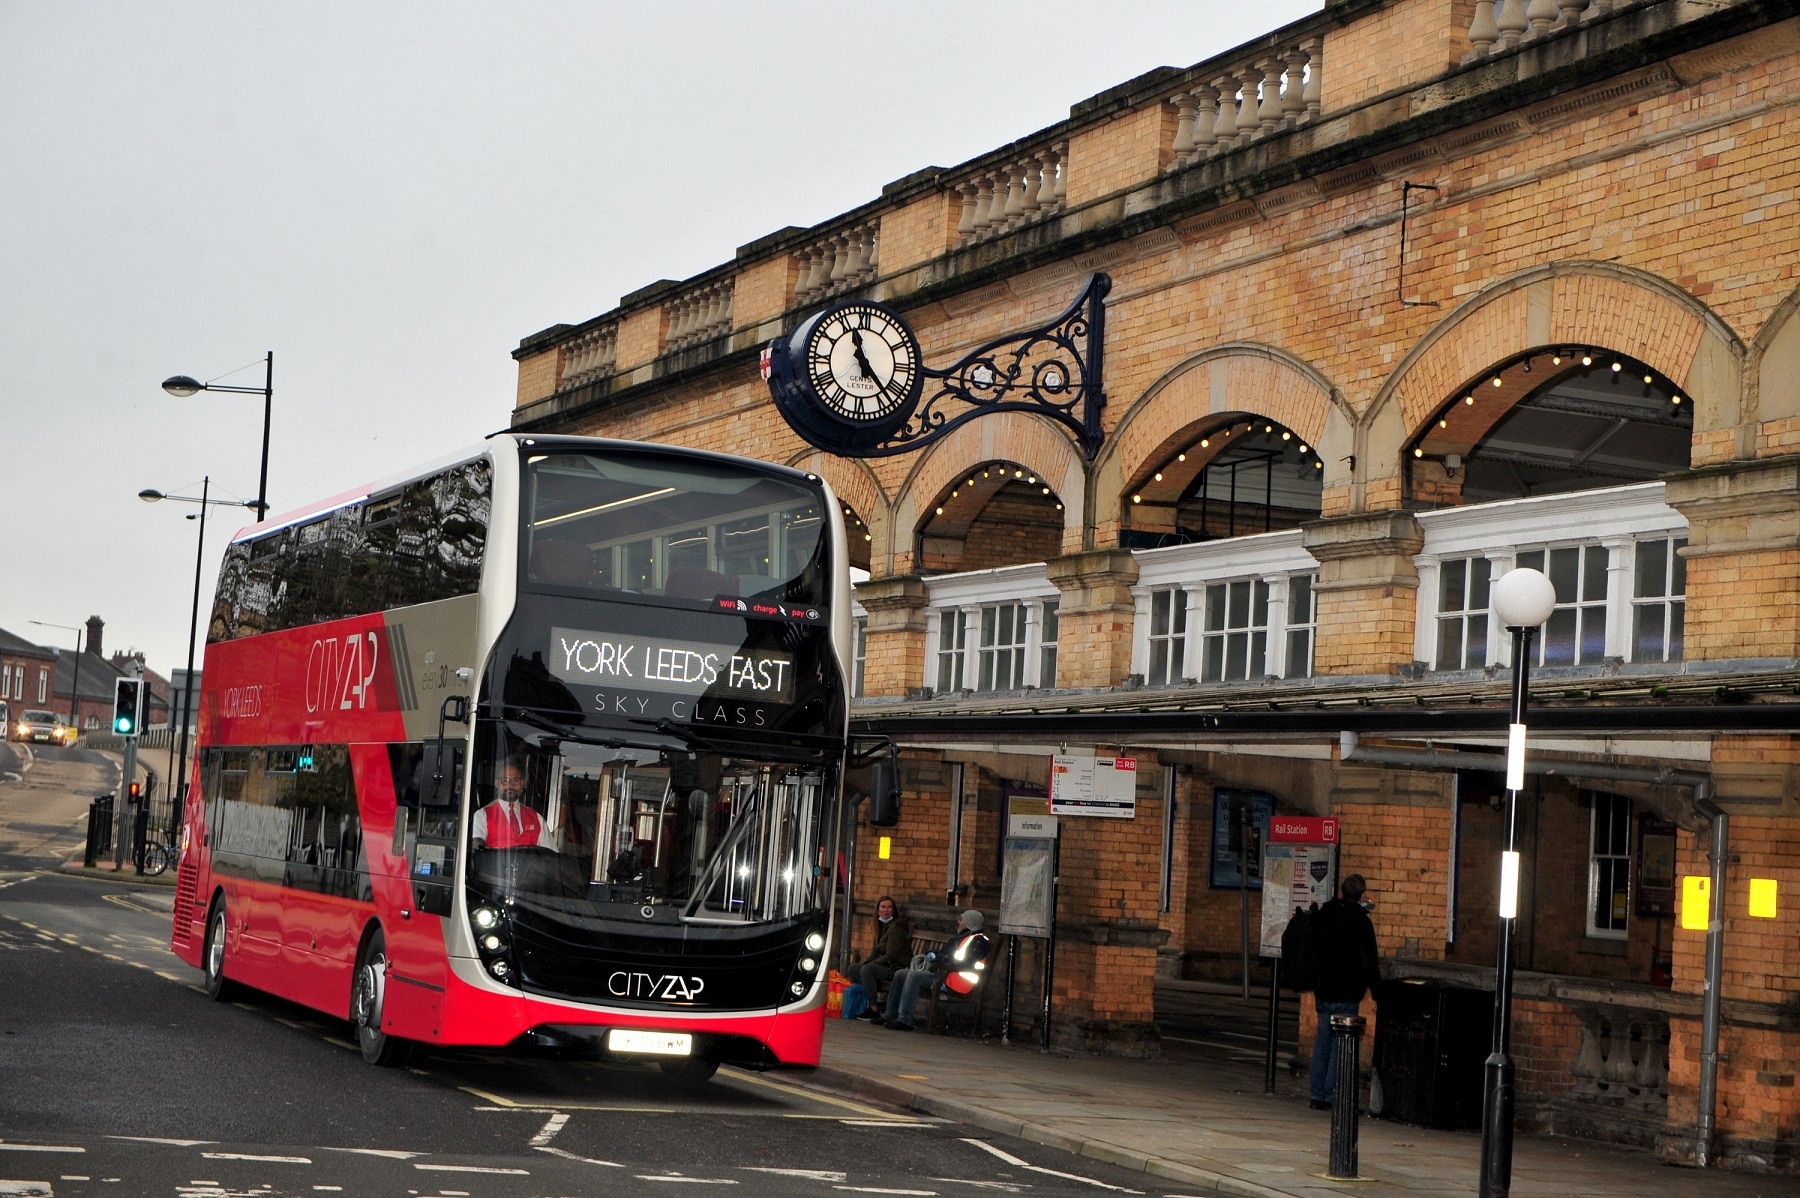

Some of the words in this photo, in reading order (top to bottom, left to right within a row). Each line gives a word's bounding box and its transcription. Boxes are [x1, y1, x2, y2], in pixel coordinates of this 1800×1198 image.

[720, 600, 736, 609] WiFi
[753, 604, 778, 615] charge
[792, 609, 805, 618] pay
[306, 631, 378, 714] CITYZAP
[438, 664, 449, 689] 30
[560, 638, 634, 678] YORK
[644, 646, 719, 685] LEEDS
[728, 655, 791, 692] FAST
[594, 693, 650, 715] SKY
[672, 700, 765, 726] CLASS
[1275, 824, 1286, 834] Rail
[1286, 824, 1308, 835] Station
[1324, 826, 1333, 836] RB
[608, 971, 705, 1000] CITYZAP
